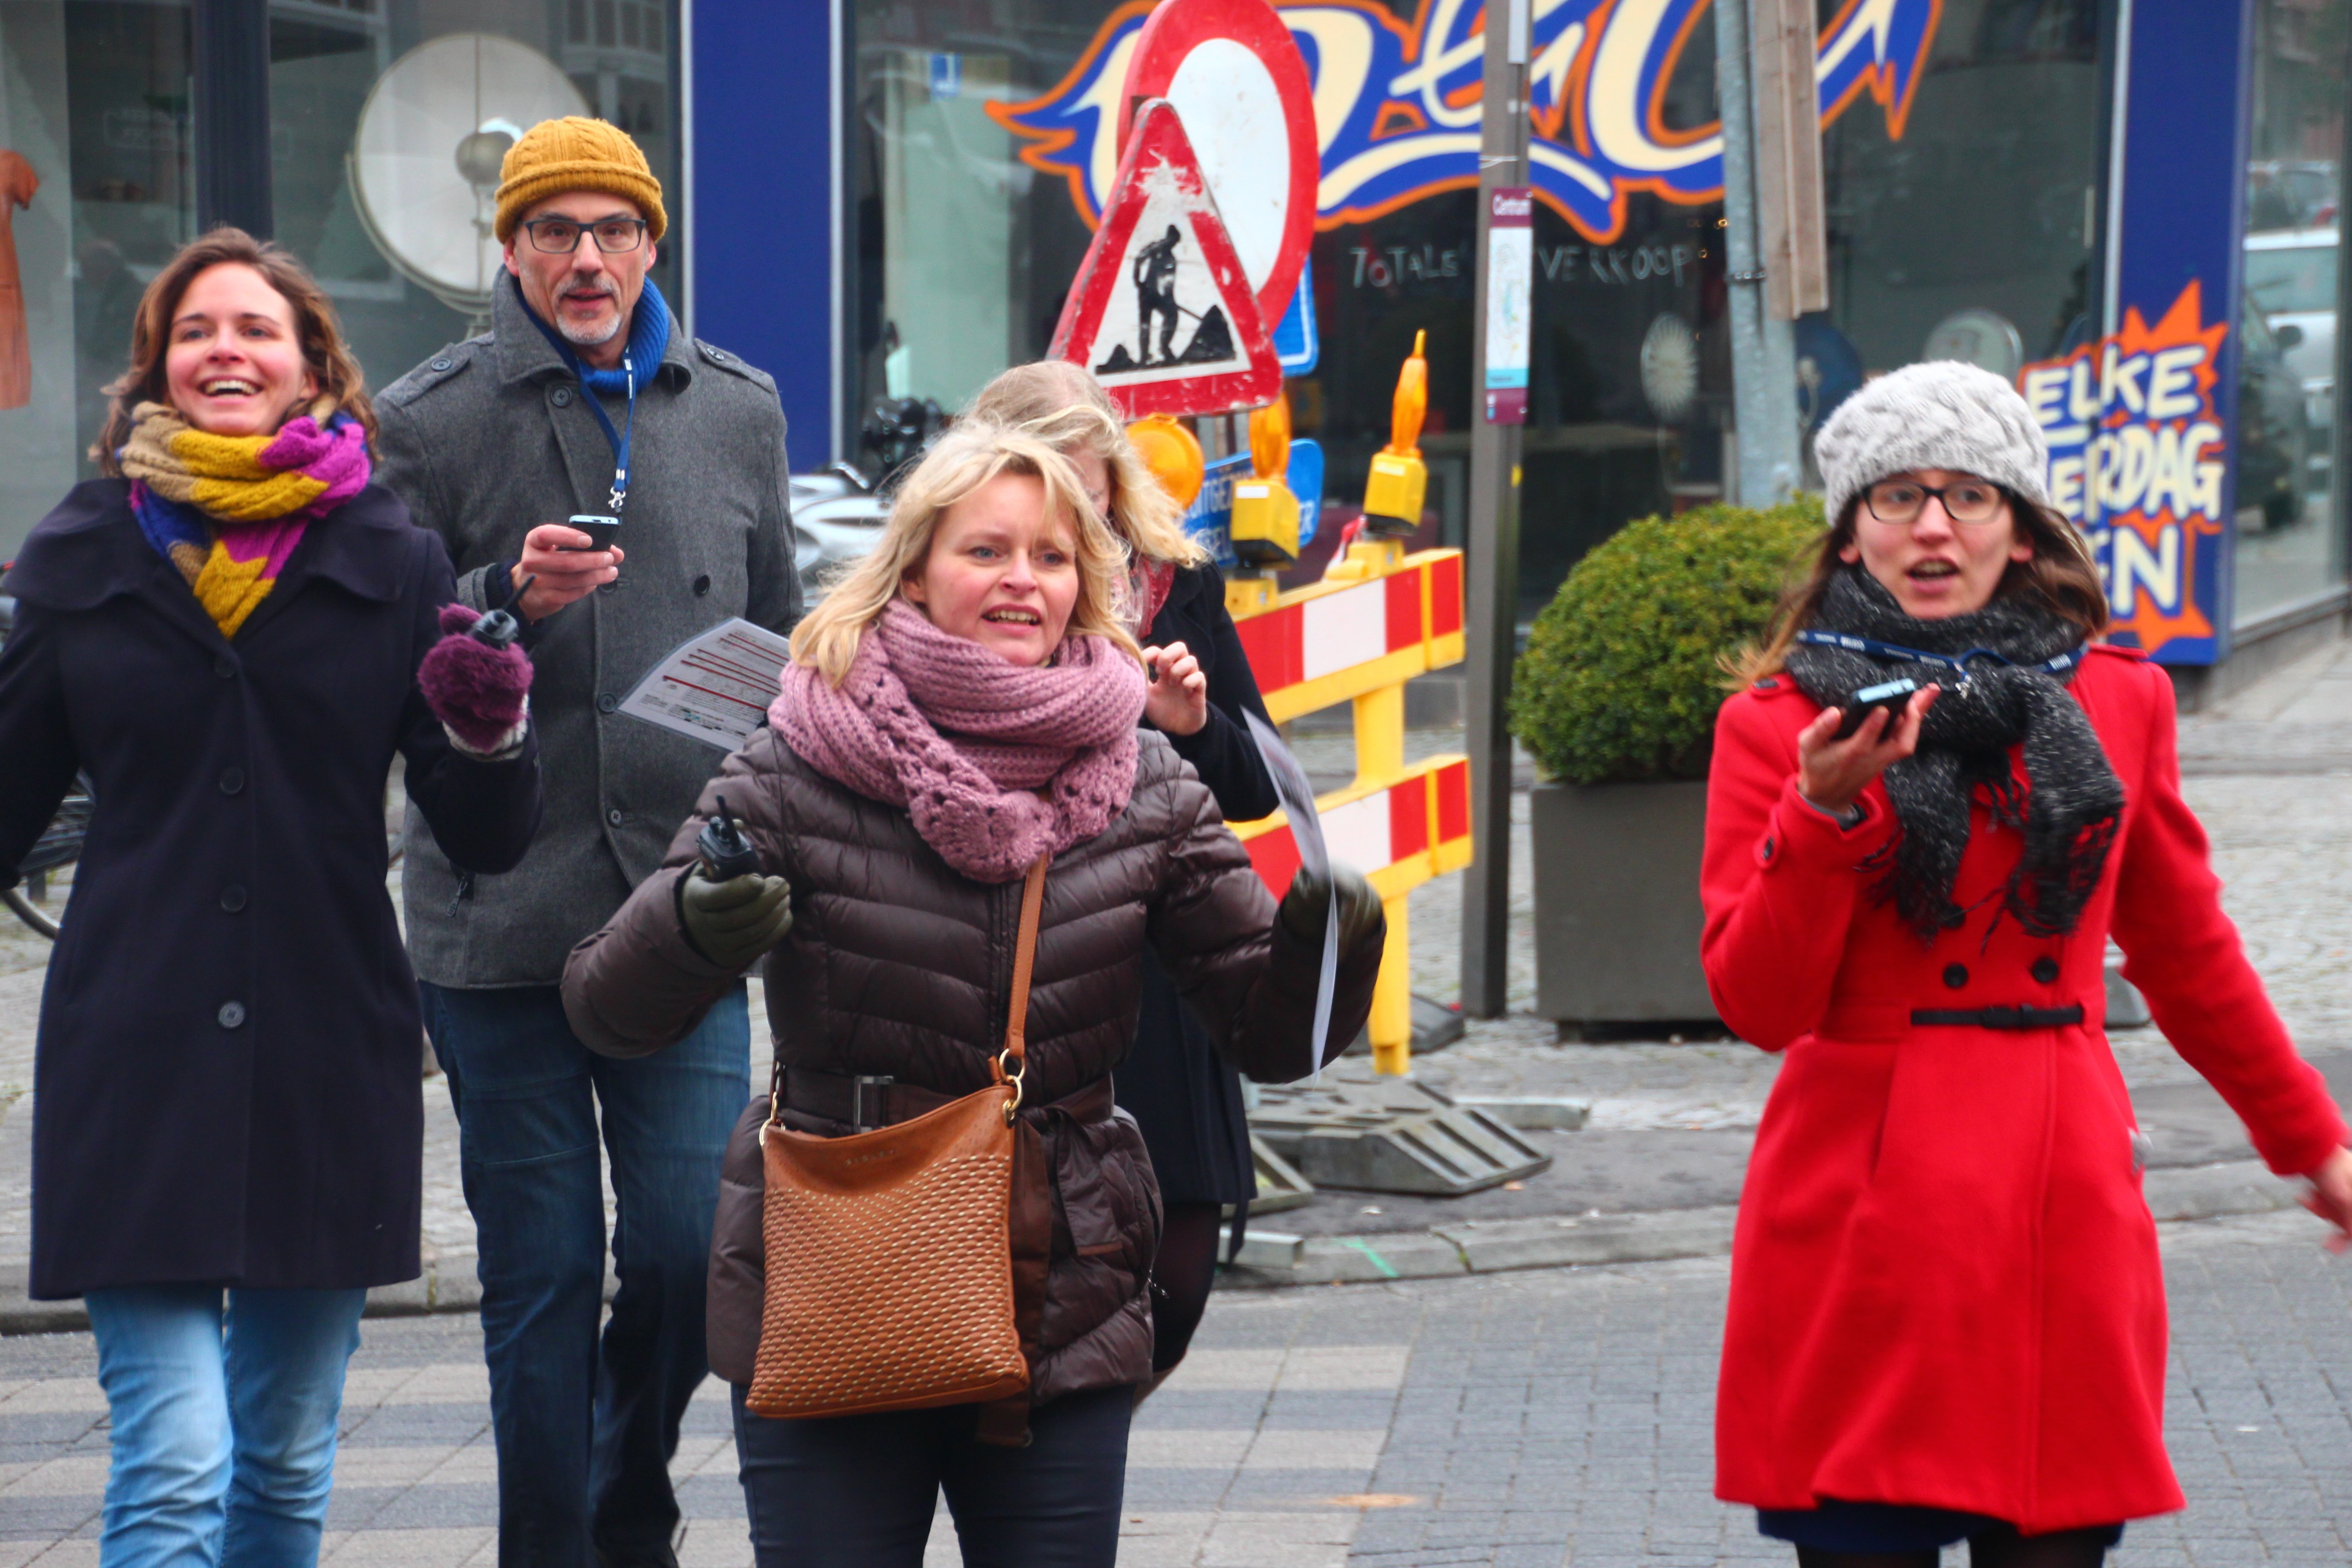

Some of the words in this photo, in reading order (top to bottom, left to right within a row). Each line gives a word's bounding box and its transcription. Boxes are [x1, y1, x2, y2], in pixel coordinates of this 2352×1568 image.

[1349, 244, 1458, 289] TOTALE
[2025, 345, 2207, 426] ELKE
[2043, 421, 2225, 521] ERDAG
